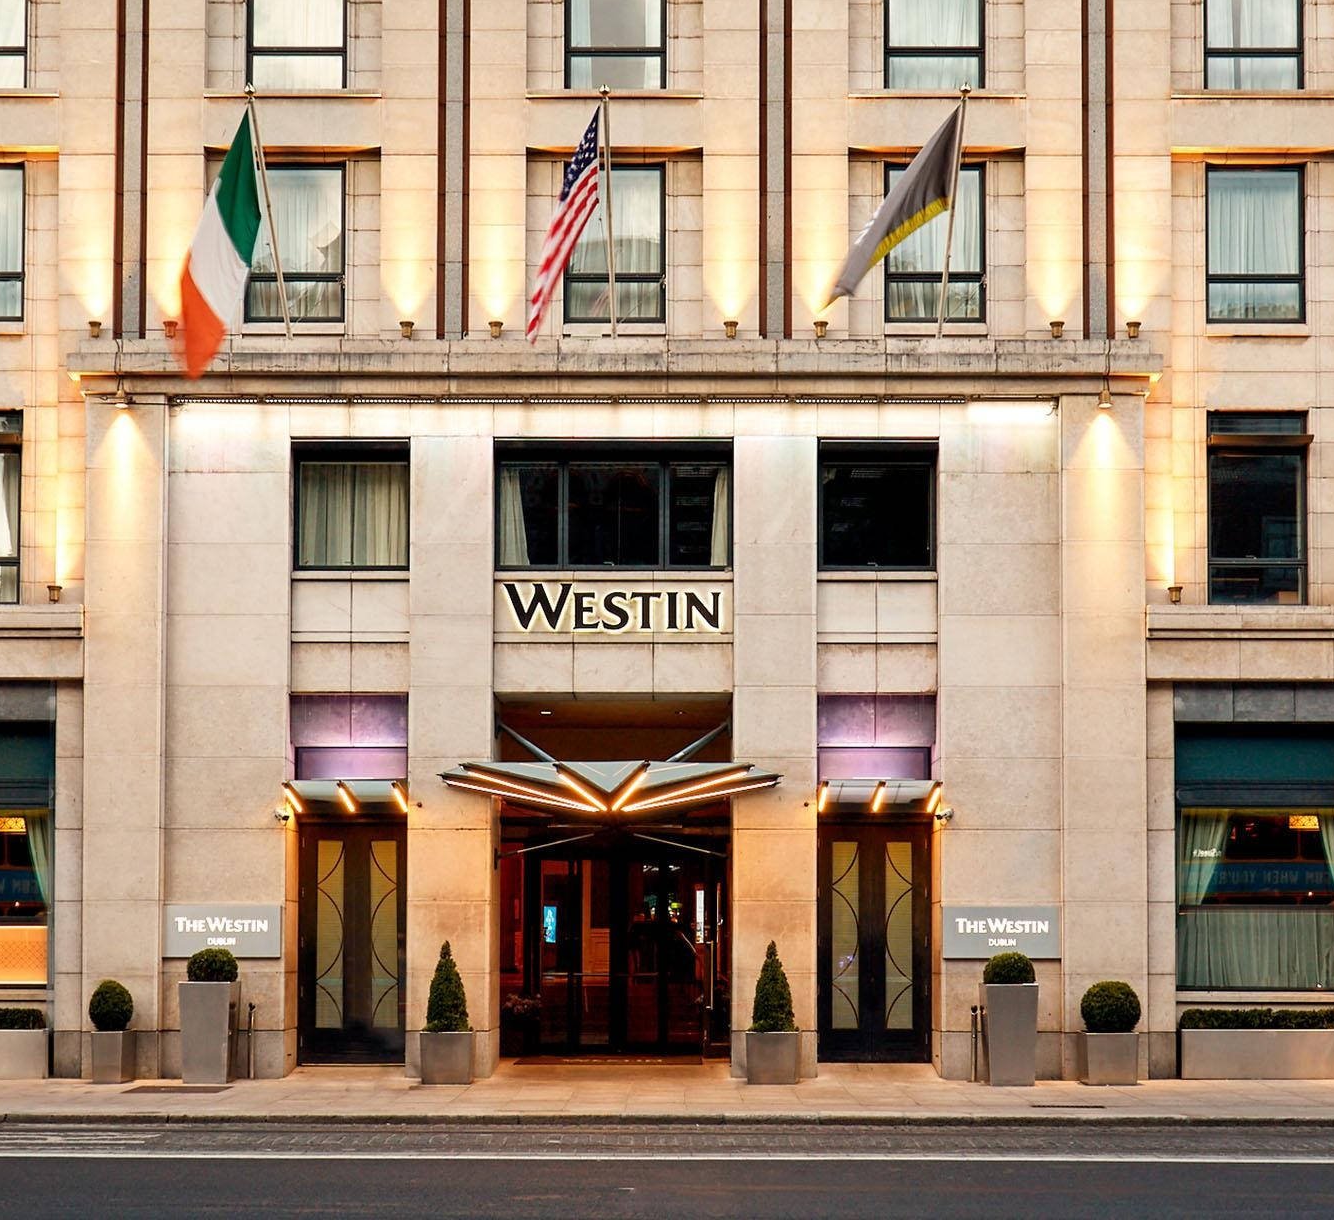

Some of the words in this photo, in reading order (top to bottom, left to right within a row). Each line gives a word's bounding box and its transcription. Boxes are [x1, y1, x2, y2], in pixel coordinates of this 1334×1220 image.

[503, 583, 721, 630] WESTIN
[207, 937, 236, 946] DUBLIN
[988, 938, 1017, 947] DUBLIN
